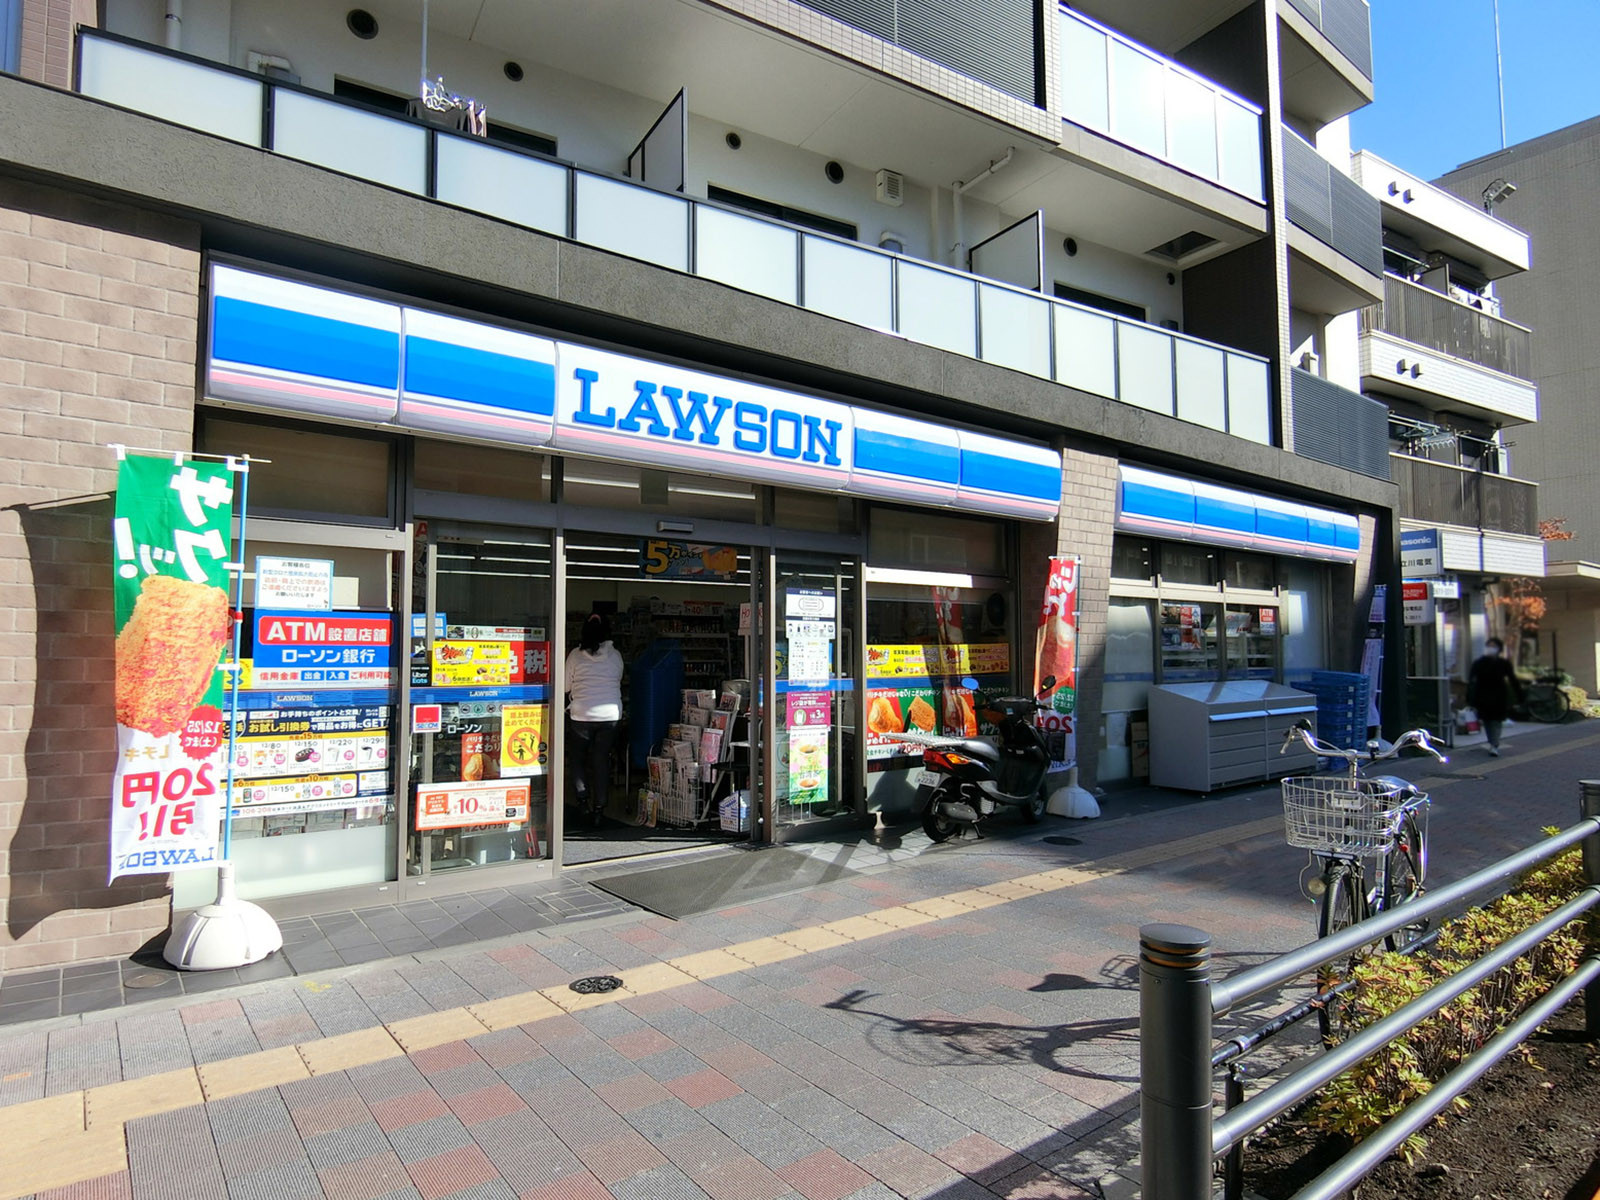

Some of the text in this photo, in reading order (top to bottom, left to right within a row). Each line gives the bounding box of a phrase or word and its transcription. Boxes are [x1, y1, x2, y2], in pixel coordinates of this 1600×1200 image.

[572, 367, 842, 467] LAWSON
[267, 621, 387, 642] ATM設置店舗
[282, 648, 375, 664] ローソン銀行
[260, 670, 391, 681] 信用金庫 出金 入金 ご利用可能
[276, 694, 313, 702] LAWSON
[448, 723, 482, 734] ローソン
